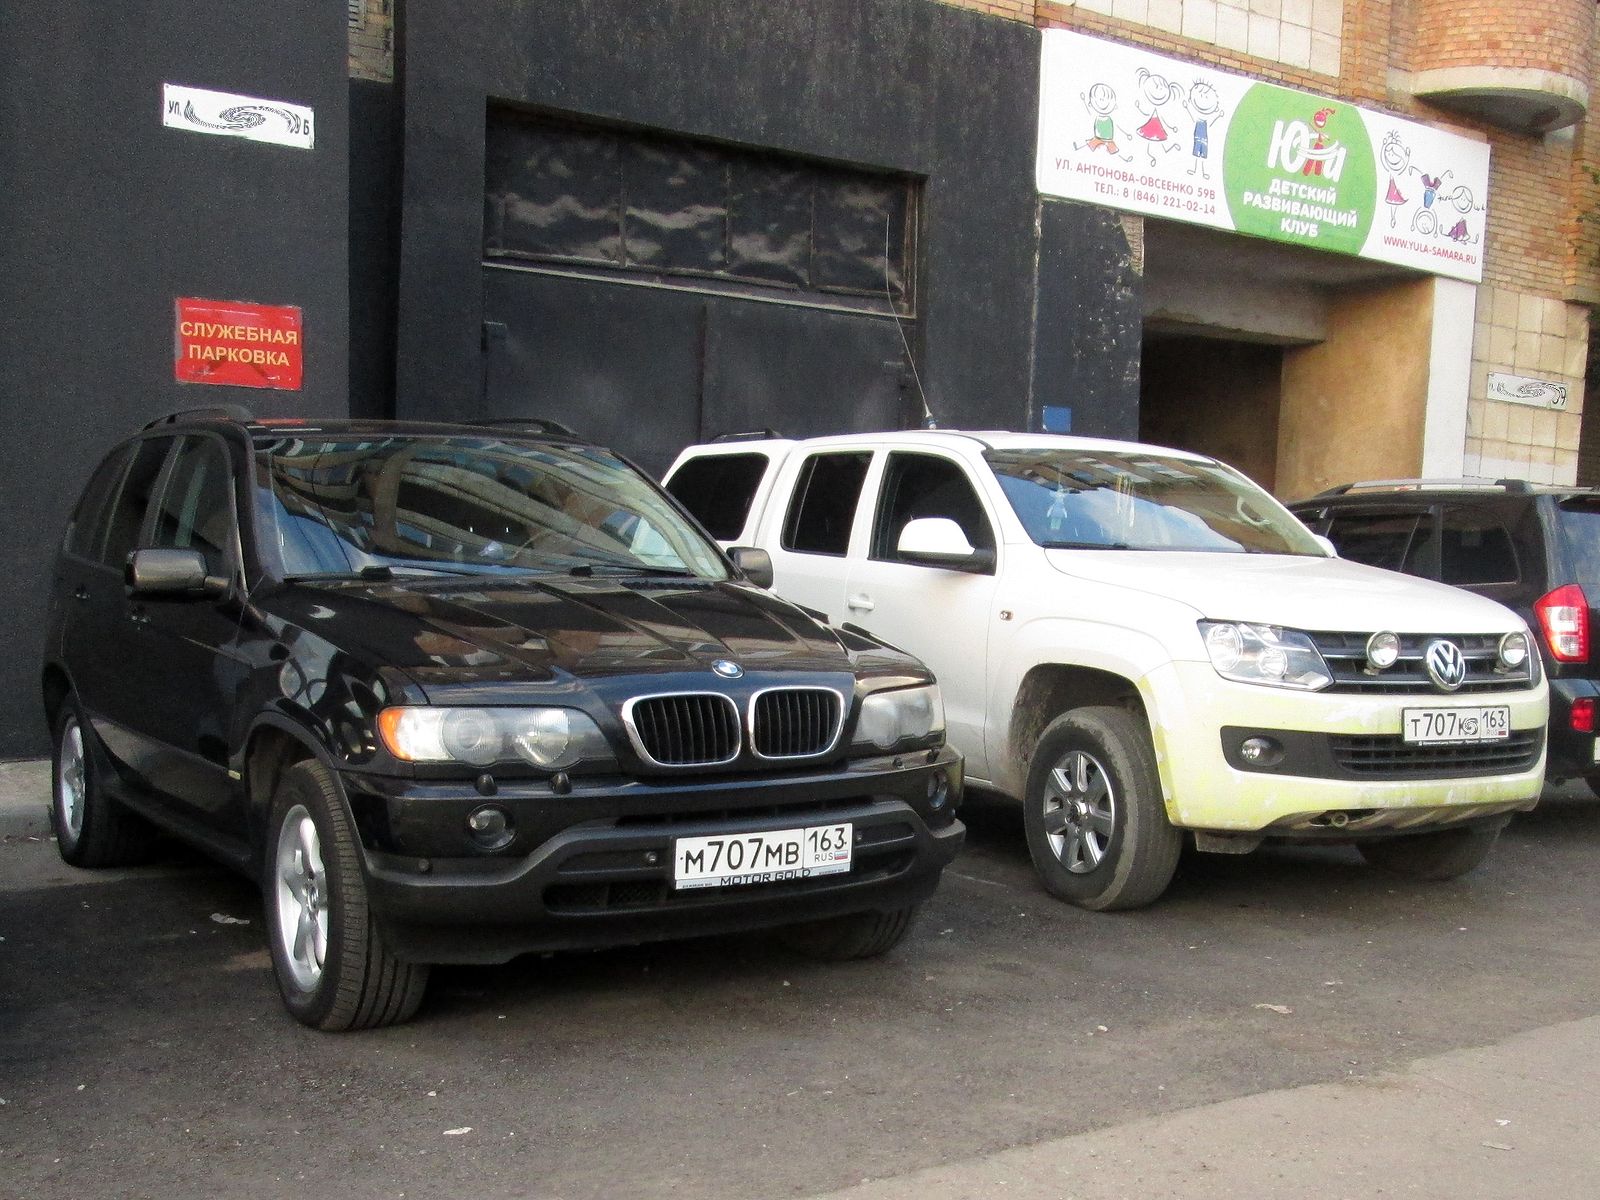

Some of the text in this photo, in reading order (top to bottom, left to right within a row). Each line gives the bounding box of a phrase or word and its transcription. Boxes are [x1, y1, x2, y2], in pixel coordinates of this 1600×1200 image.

[1055, 157, 1073, 171] УЛ.
[1076, 162, 1194, 195] АНТОНОВА-ОВСЕЕНКО
[1094, 181, 1216, 215] ТЕЛ.: 8 (846) 221-02-14
[1269, 178, 1337, 205] ДЕТСКИЙ
[1243, 191, 1359, 228] РАЗВИВАЮЩИЙ
[1281, 217, 1319, 238] КЛУБ
[1383, 235, 1477, 264] WWW.YULA-SAMARA.RU
[180, 321, 298, 346] СЛУЖЕБНАЯ
[189, 344, 290, 367] ПАРКОВКА
[1411, 710, 1505, 737] Т707К 163
[808, 827, 845, 852] 163
[814, 851, 834, 862] RUS
[720, 874, 772, 886] MOTOR
[775, 868, 811, 881] GOLD
